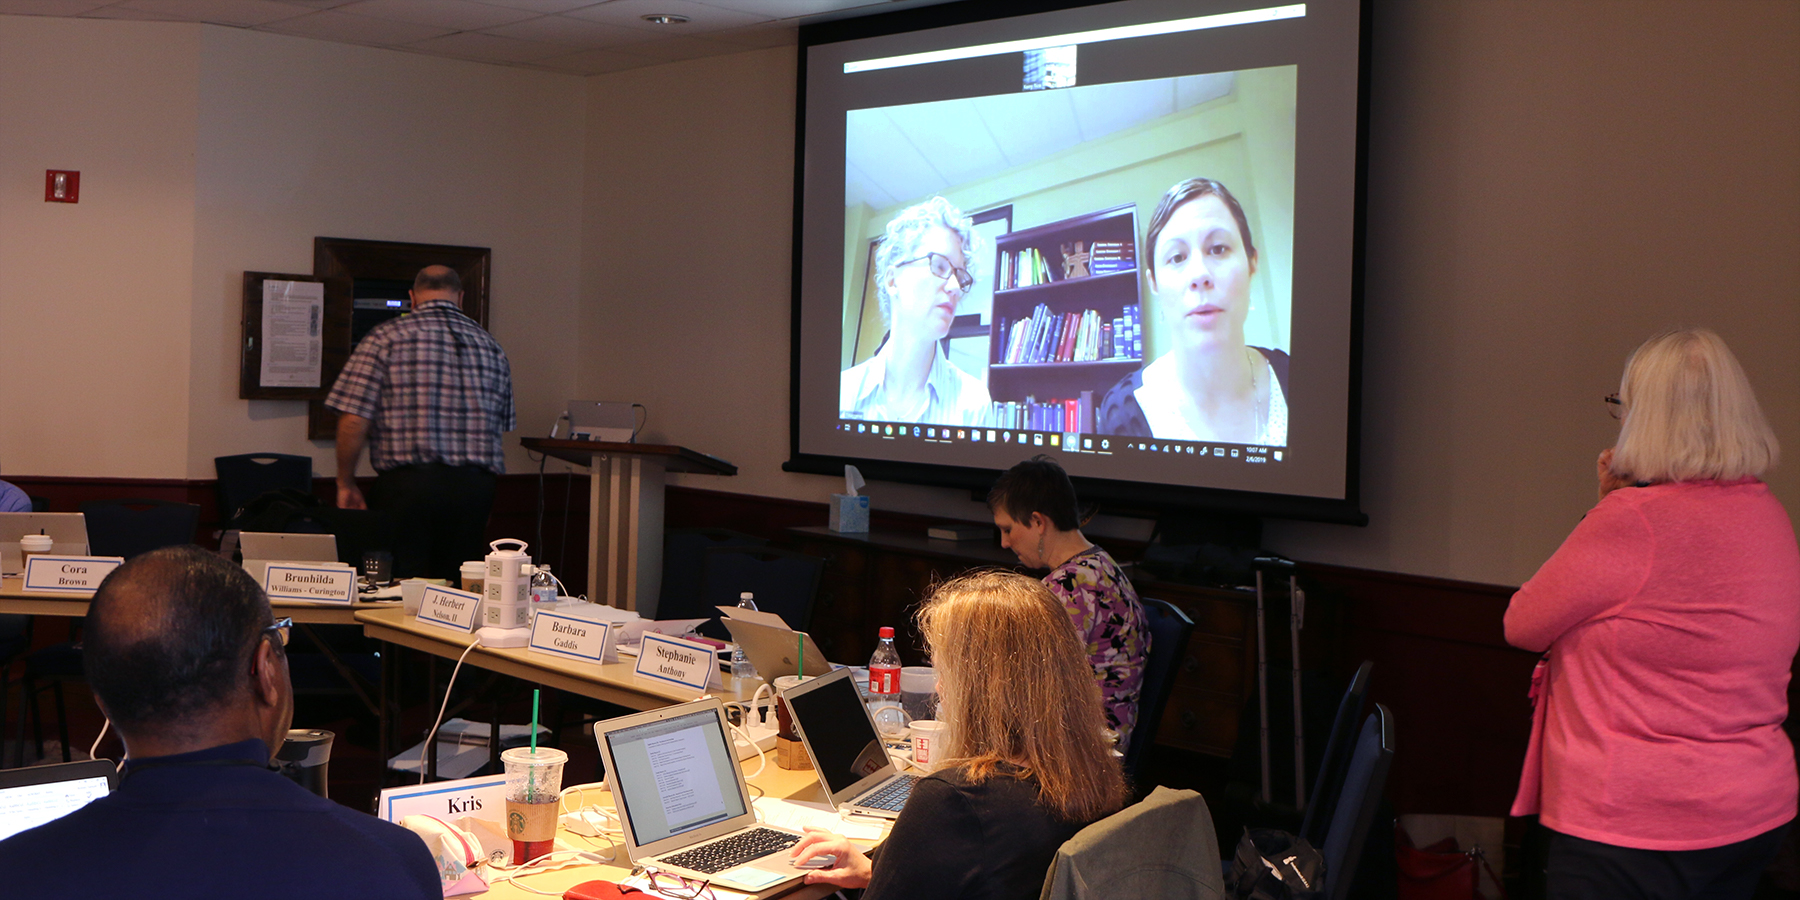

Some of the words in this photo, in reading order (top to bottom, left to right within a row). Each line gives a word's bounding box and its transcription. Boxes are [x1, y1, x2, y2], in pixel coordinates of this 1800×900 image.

[61, 564, 87, 574] Cora
[58, 577, 87, 586] Brown
[285, 572, 334, 584] Brunhilda
[271, 585, 302, 593] Williams
[309, 587, 346, 597] Curington
[432, 594, 438, 605] J.
[439, 596, 465, 610] Herbert
[433, 609, 450, 621] Nelson,
[451, 613, 458, 622] II
[552, 621, 587, 637] Barbara
[553, 637, 578, 650] Gaddis
[656, 645, 696, 665] Stephanie
[657, 664, 687, 680] Anthony
[448, 795, 483, 814] Kris
